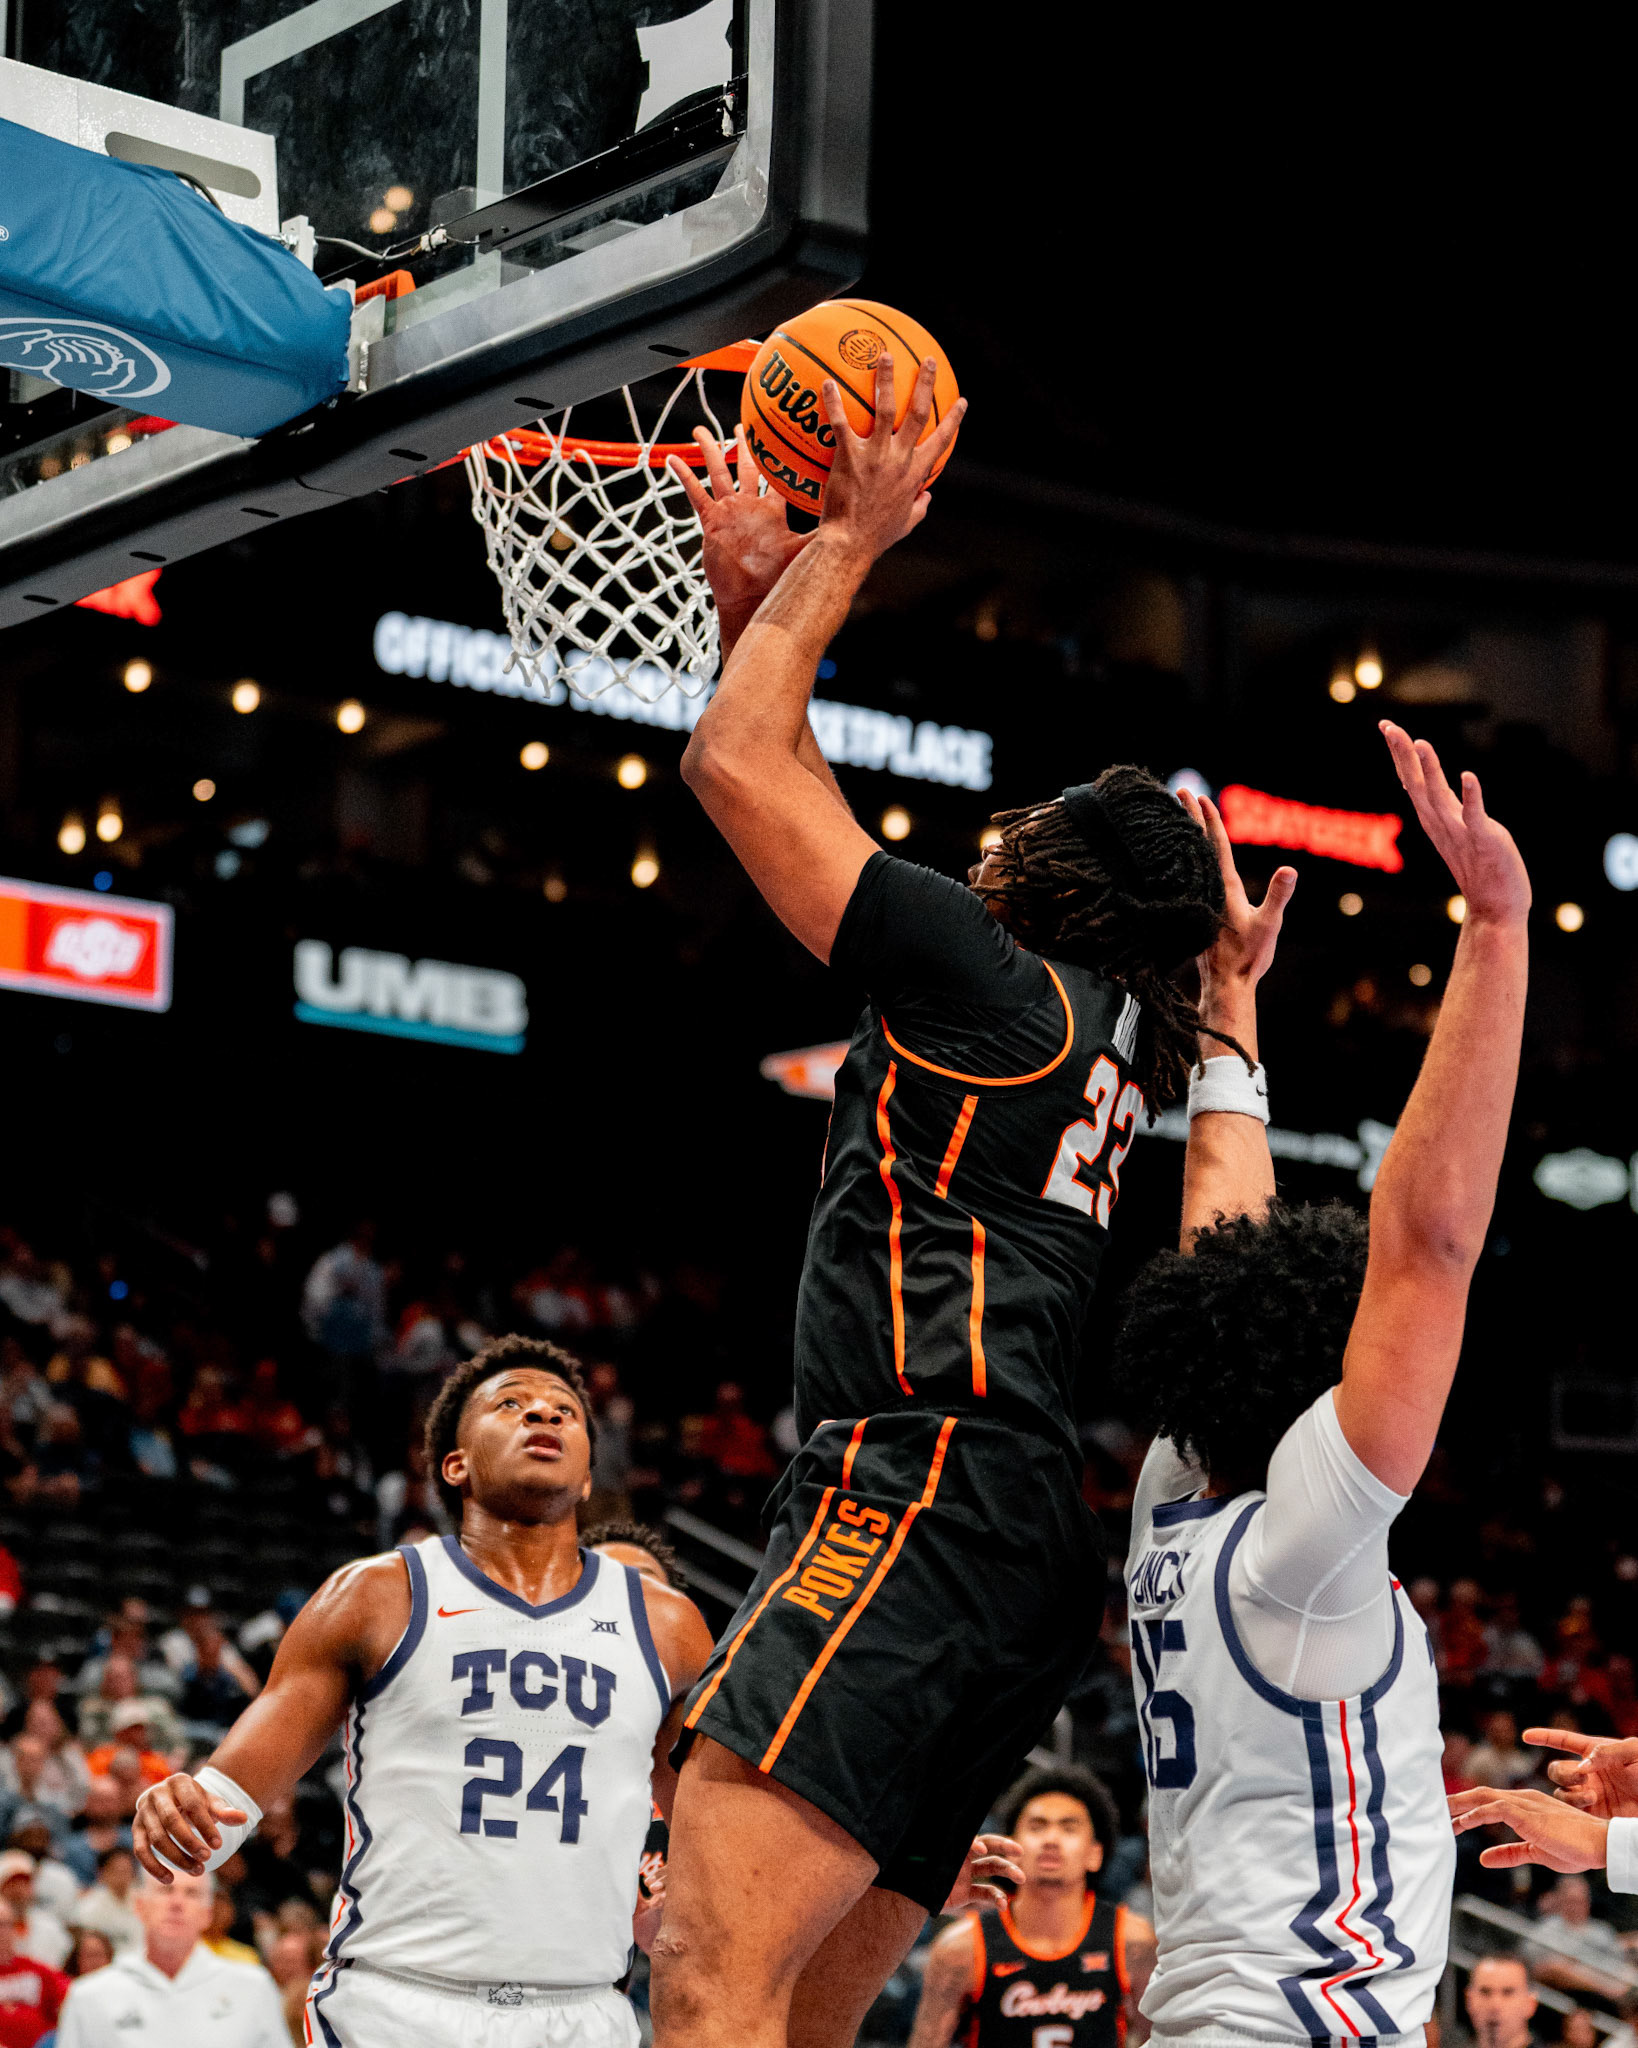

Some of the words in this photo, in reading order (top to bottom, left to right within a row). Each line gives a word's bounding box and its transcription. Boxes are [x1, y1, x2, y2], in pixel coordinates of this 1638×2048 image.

[759, 349, 838, 449] Wilso
[746, 423, 822, 501] NCAA
[293, 939, 529, 1037] UMB
[1040, 1053, 1144, 1231] 23
[781, 1498, 891, 1622] POKES
[1129, 1551, 1192, 1605] UNC
[451, 1648, 617, 1730] TCU
[1130, 1619, 1198, 1790] 15
[459, 1736, 589, 1846] 24
